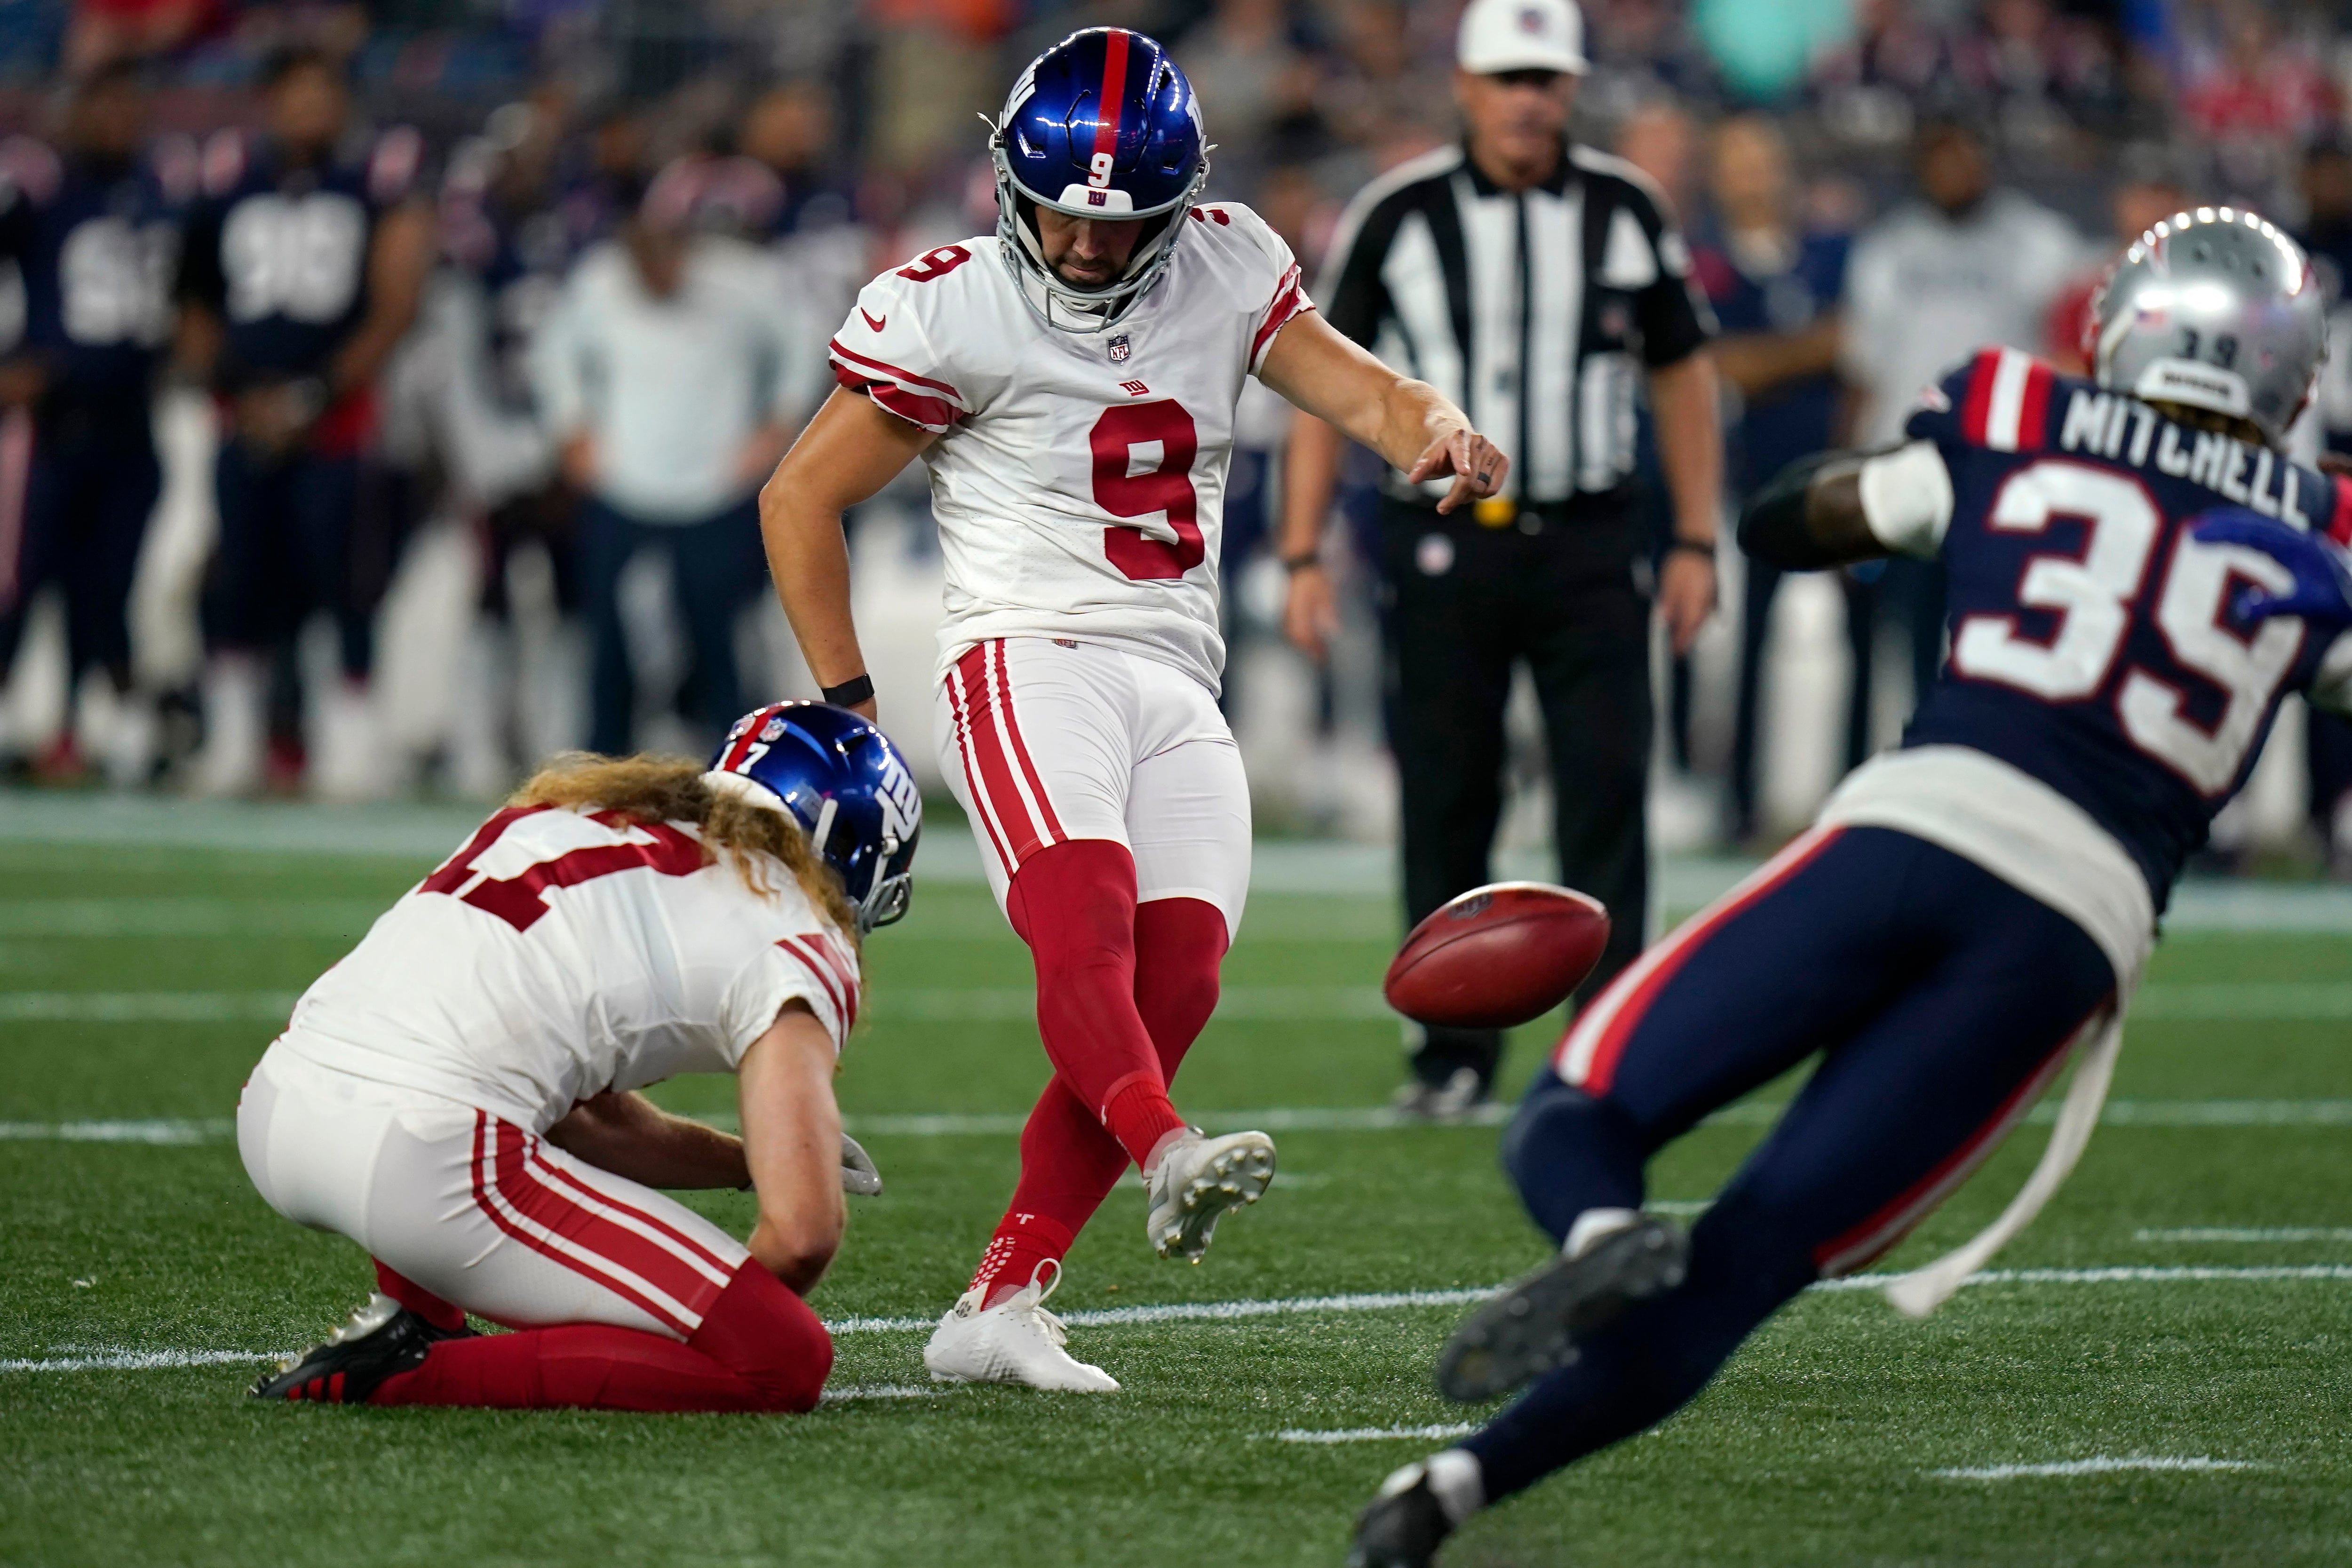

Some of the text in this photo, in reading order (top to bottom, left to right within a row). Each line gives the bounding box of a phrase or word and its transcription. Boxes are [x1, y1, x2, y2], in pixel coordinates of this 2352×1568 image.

[1088, 152, 1114, 188] 9
[896, 245, 972, 283] 9
[1089, 398, 1205, 581] 9
[2060, 388, 2310, 533] MITCHELL
[1951, 455, 2306, 798] 39
[713, 741, 771, 775] 17
[416, 802, 719, 934] 17
